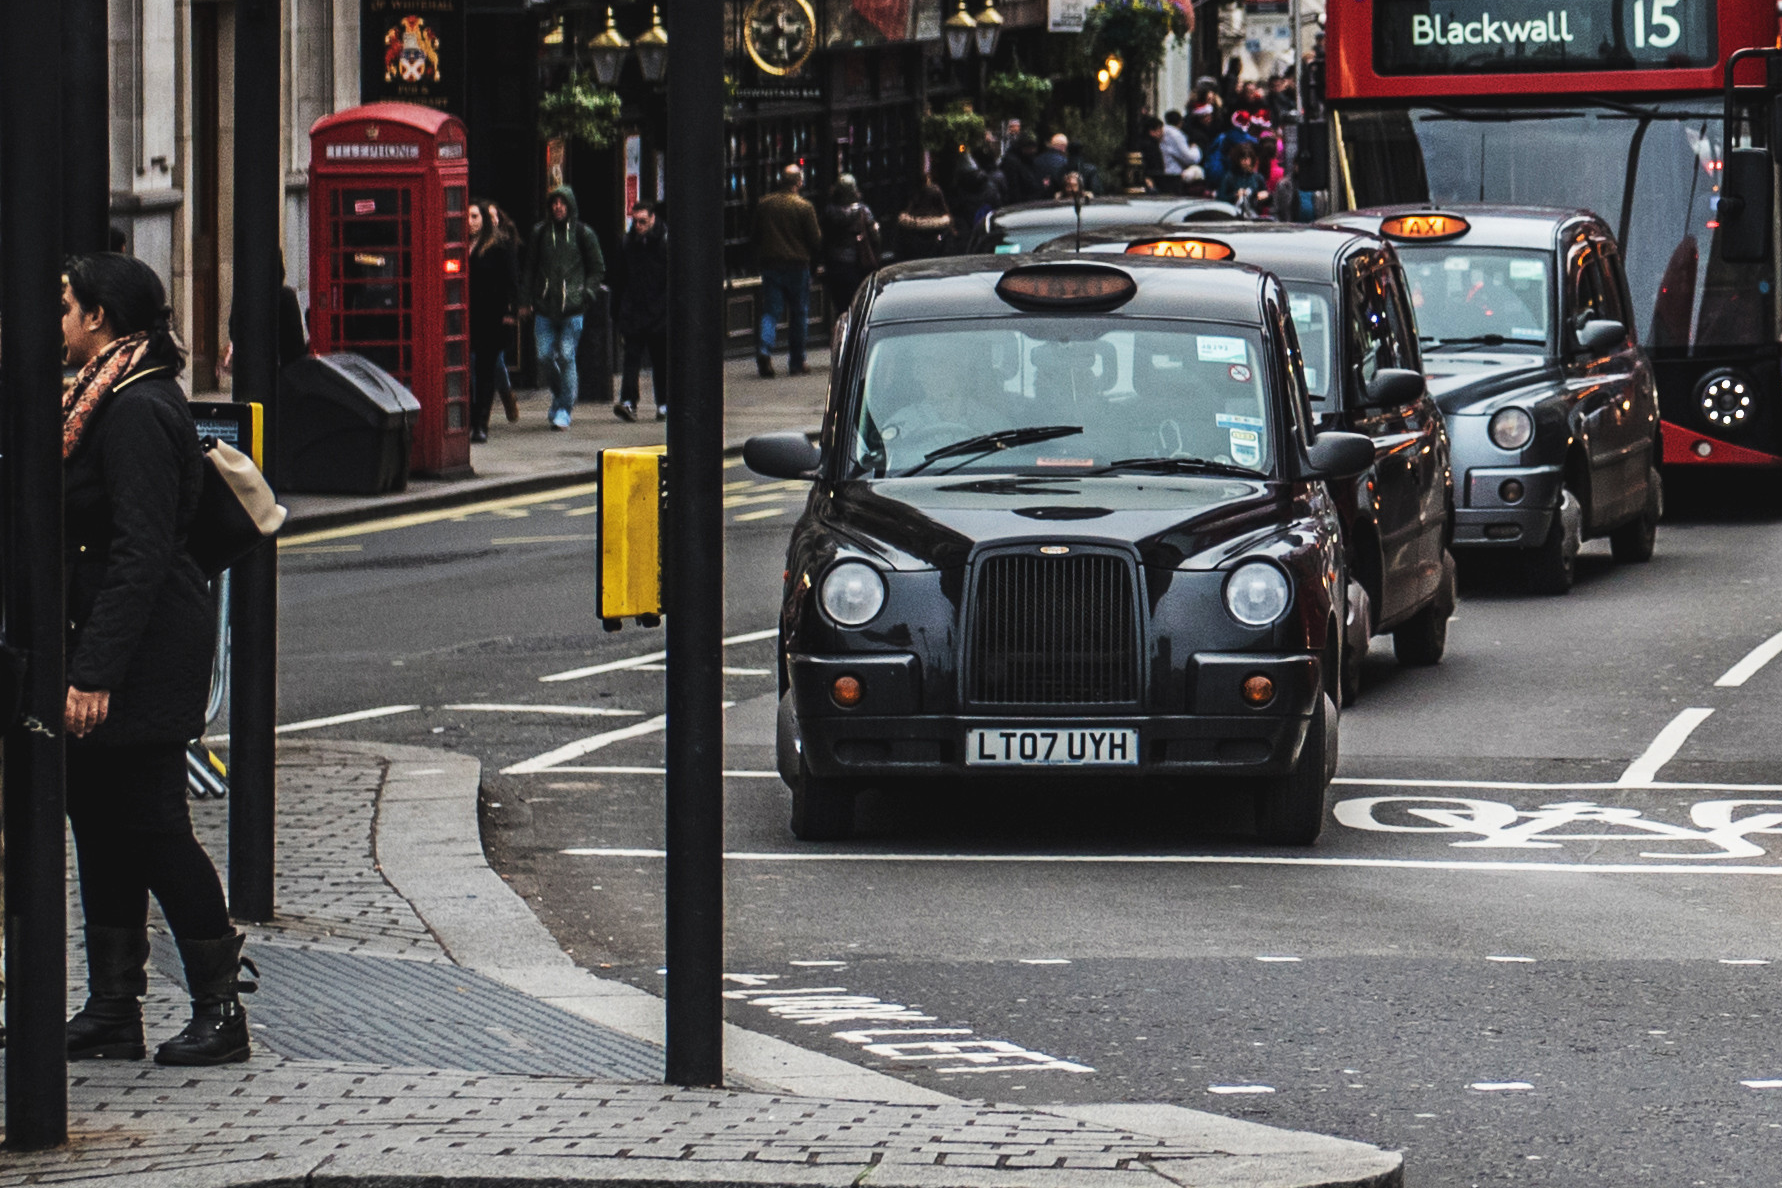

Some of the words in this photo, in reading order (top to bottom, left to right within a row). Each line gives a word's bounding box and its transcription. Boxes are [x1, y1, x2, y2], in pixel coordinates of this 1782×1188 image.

[1412, 10, 1574, 45] Blackwall
[326, 144, 420, 159] TELEPHONE
[1396, 220, 1446, 235] TAXI
[978, 732, 1059, 761] LT07
[1068, 732, 1128, 761] UYH
[830, 1027, 1097, 1075] LEFT
